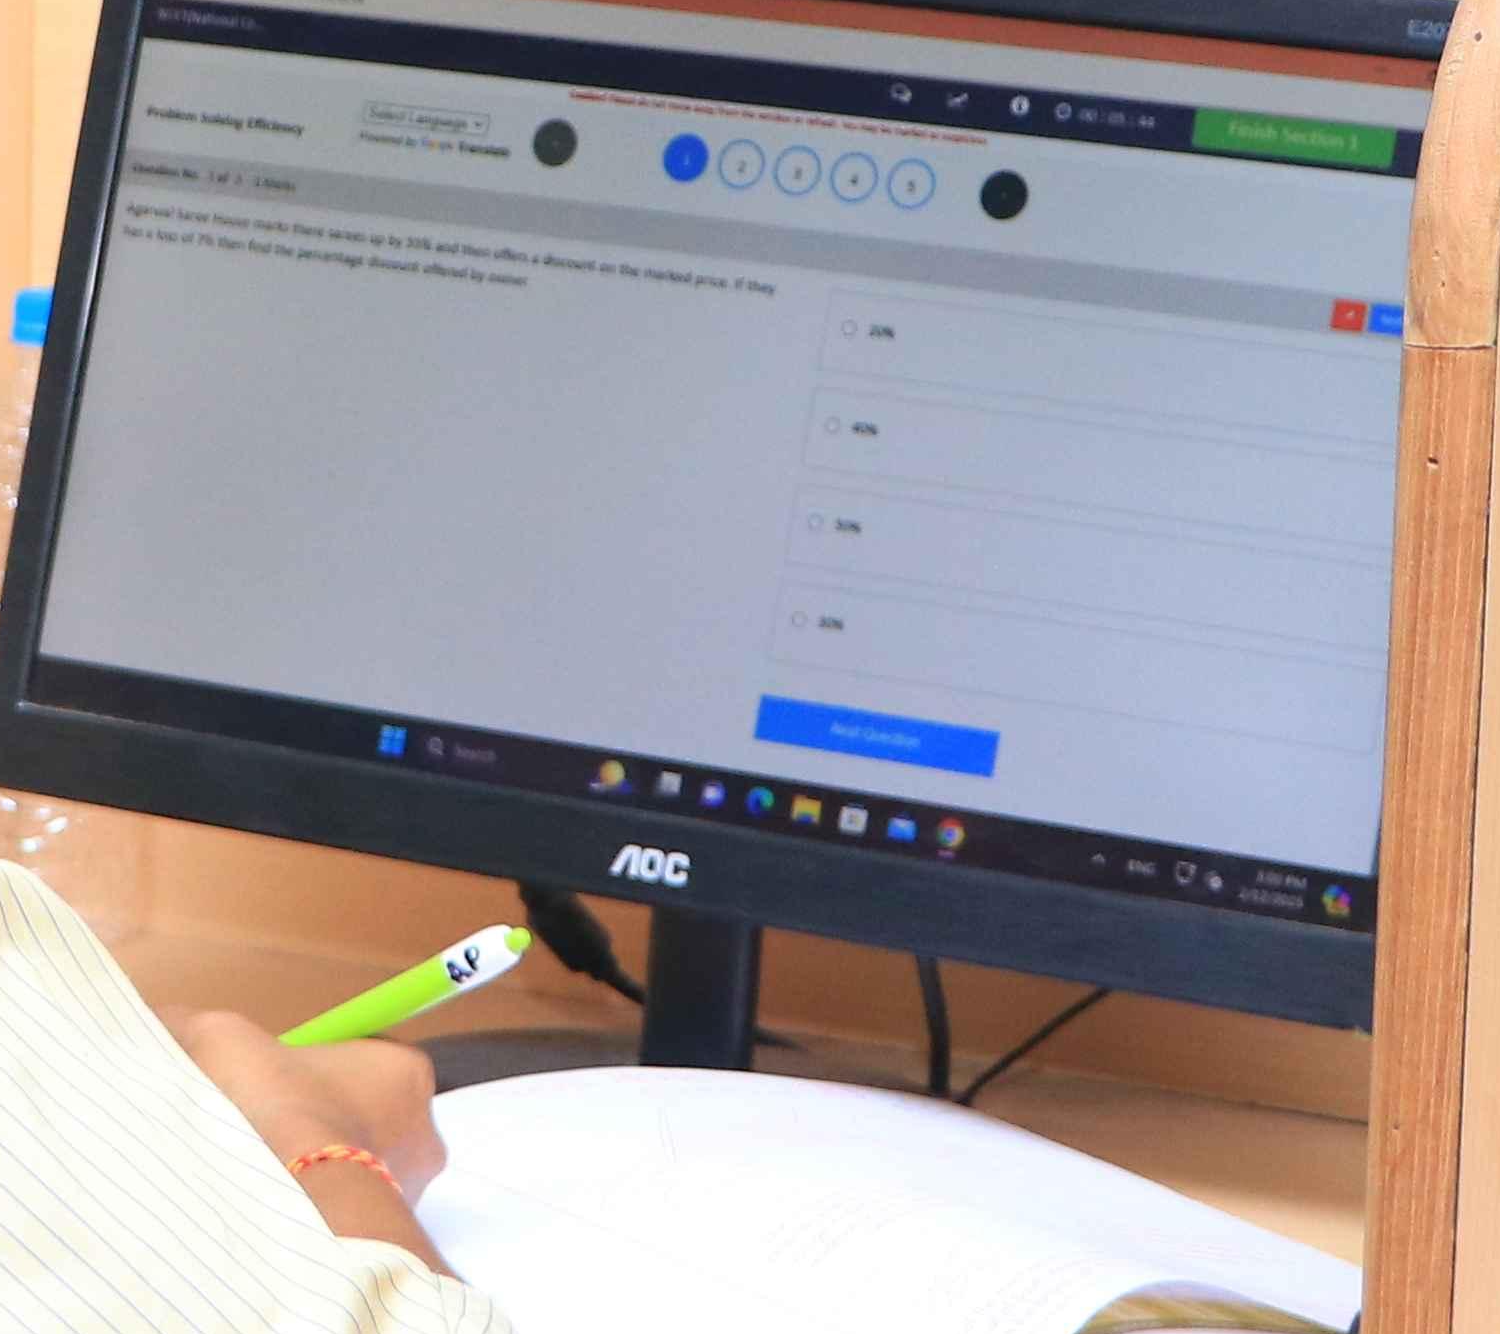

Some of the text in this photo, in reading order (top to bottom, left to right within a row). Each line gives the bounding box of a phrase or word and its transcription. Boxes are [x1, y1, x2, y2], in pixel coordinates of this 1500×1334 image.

[147, 105, 304, 138] Problem Solving Efficiency
[370, 105, 468, 132] Select Language
[1229, 120, 1276, 140] Finish
[1281, 127, 1344, 149] Section
[457, 140, 511, 158] Translate
[123, 224, 143, 238] has
[156, 228, 178, 244] loss
[181, 232, 195, 244] of
[217, 235, 245, 252] then
[248, 239, 273, 255] find
[275, 242, 294, 258] the
[297, 247, 363, 269] percentage
[367, 256, 419, 272] discount
[423, 260, 468, 278] offered
[470, 269, 485, 283] by
[126, 201, 175, 220] Agarwal
[253, 218, 289, 233] marks
[370, 233, 385, 247] up
[388, 235, 402, 248] by
[436, 239, 459, 255] and
[462, 243, 490, 258] then
[493, 246, 528, 264] offers
[543, 252, 595, 272] discount
[599, 262, 616, 274] on
[620, 263, 639, 278] the
[643, 268, 691, 284] marked
[748, 278, 776, 296] they
[608, 843, 691, 888] AOC
